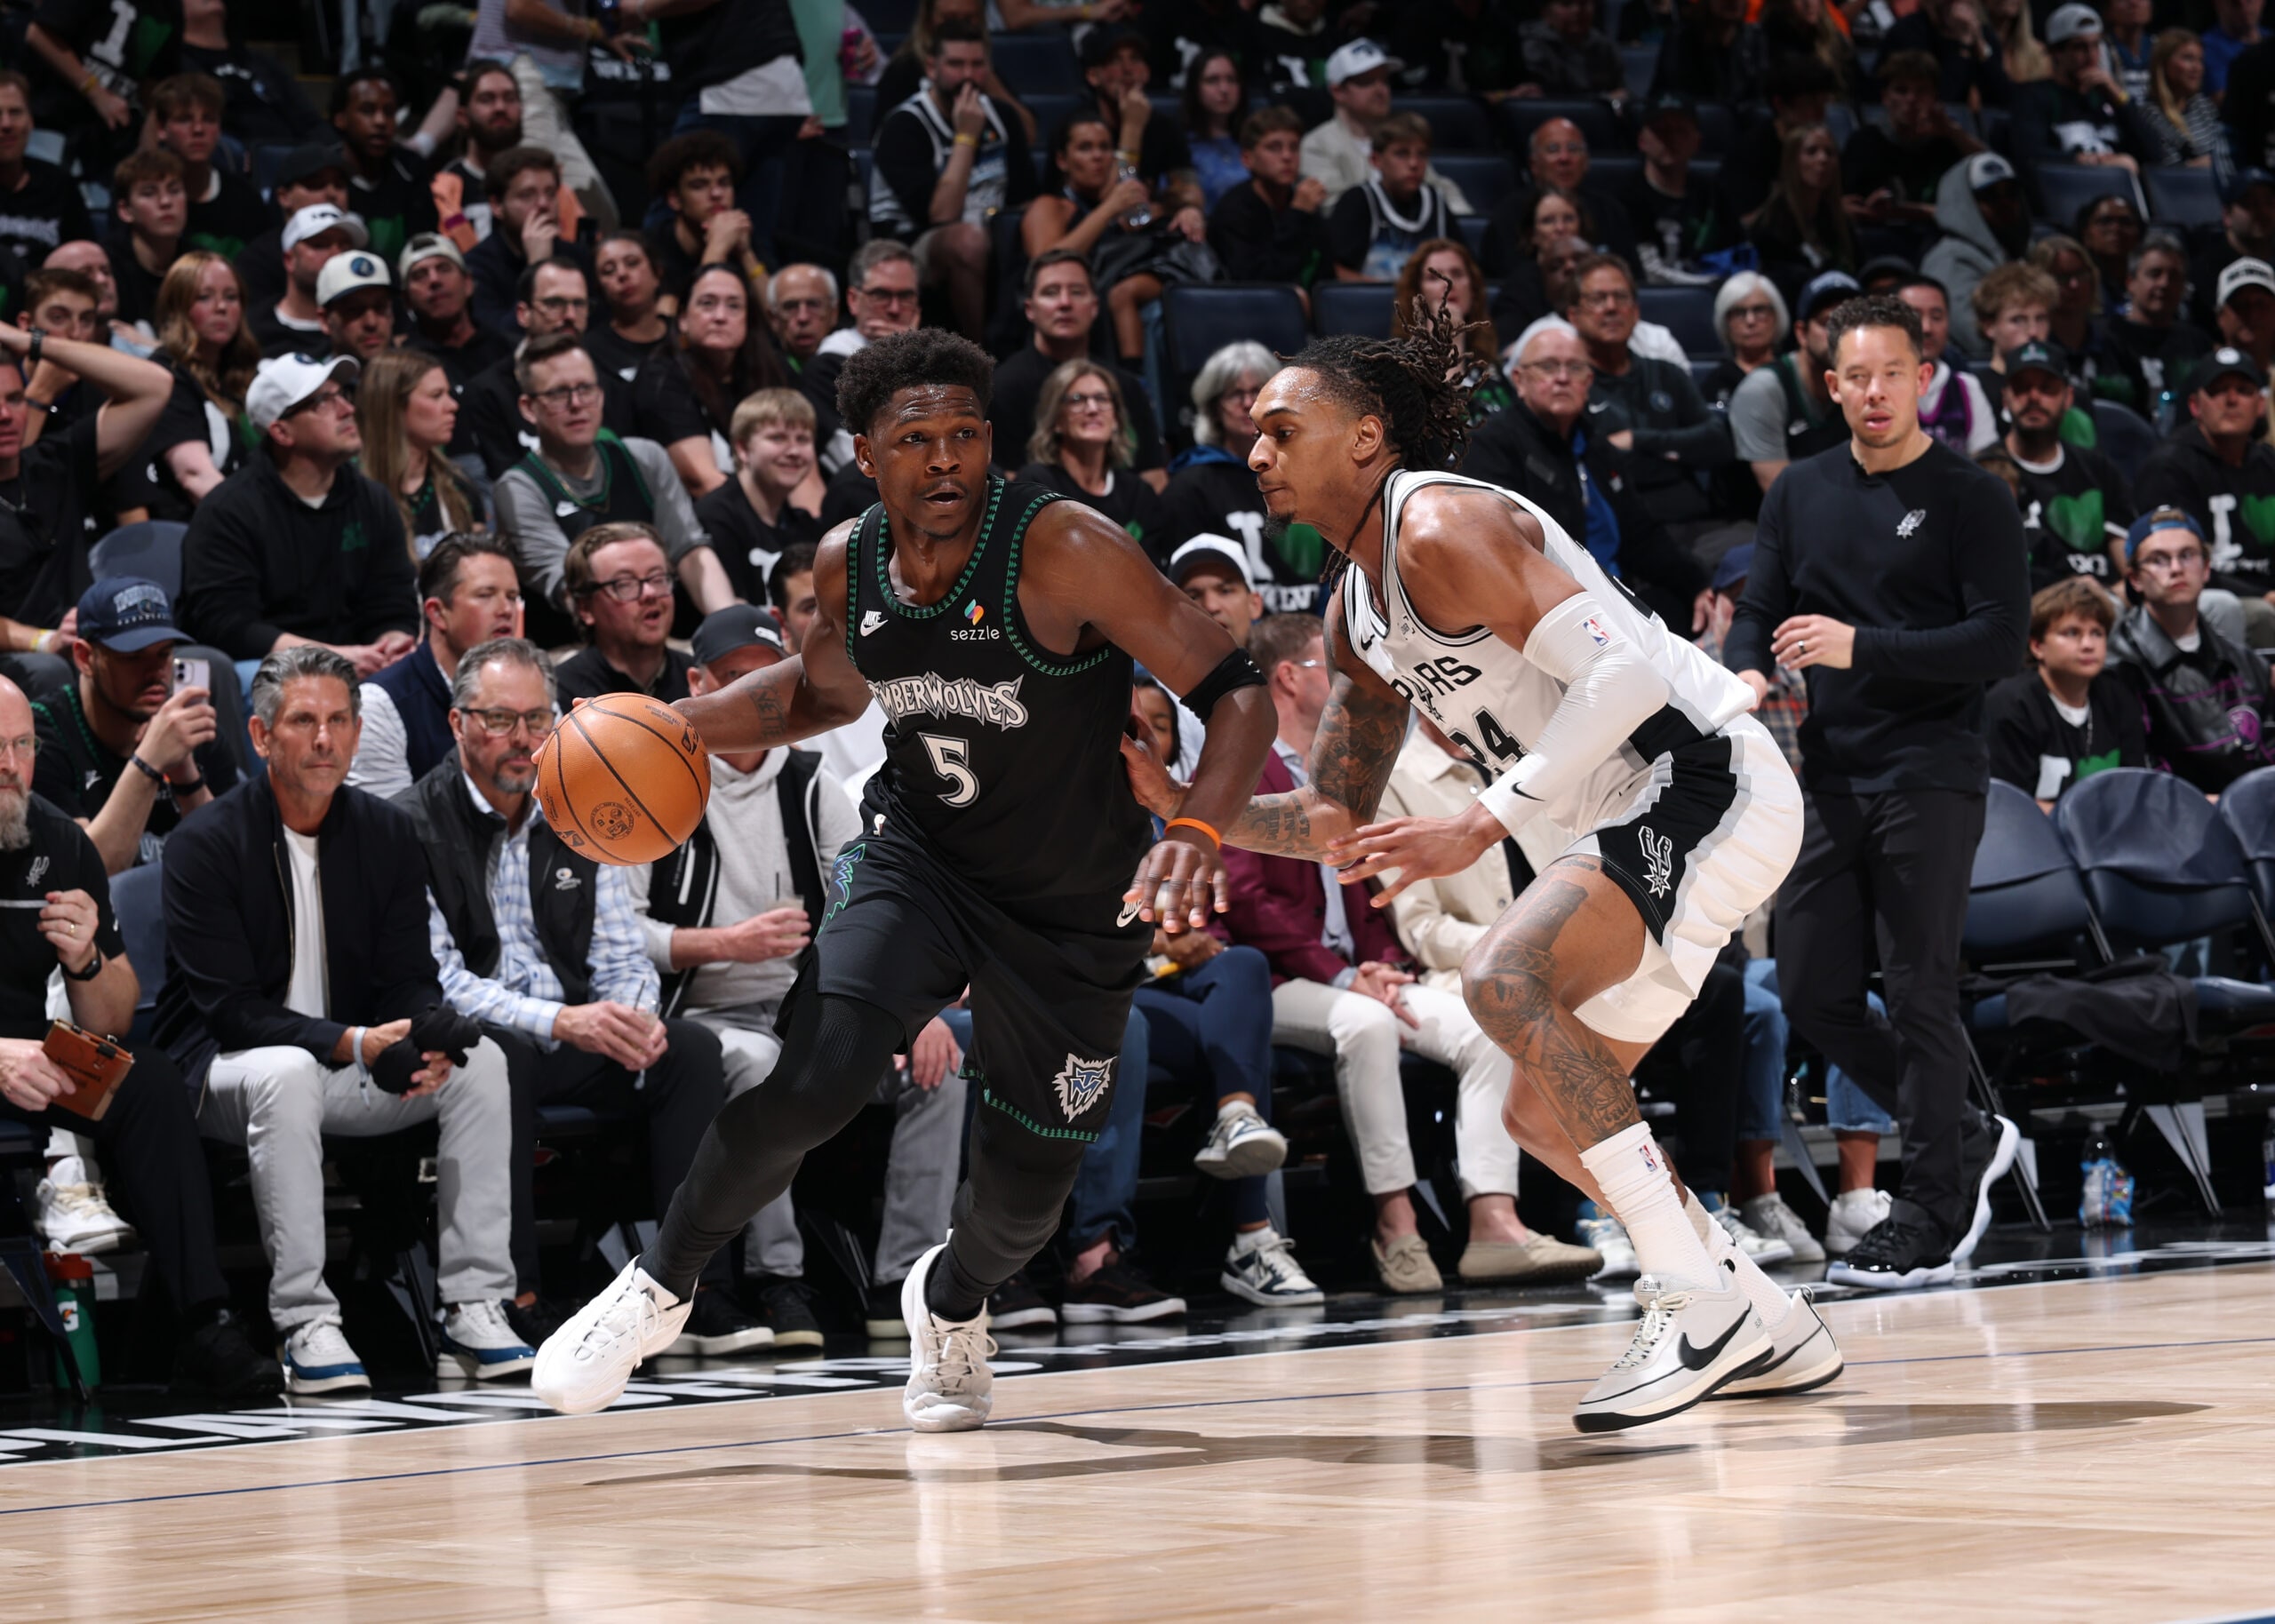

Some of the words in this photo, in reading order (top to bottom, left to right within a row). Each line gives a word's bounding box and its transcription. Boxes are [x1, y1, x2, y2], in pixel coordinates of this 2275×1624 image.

[865, 609, 882, 626] NIKE
[950, 625, 1001, 641] sezzle
[916, 731, 980, 808] 5
